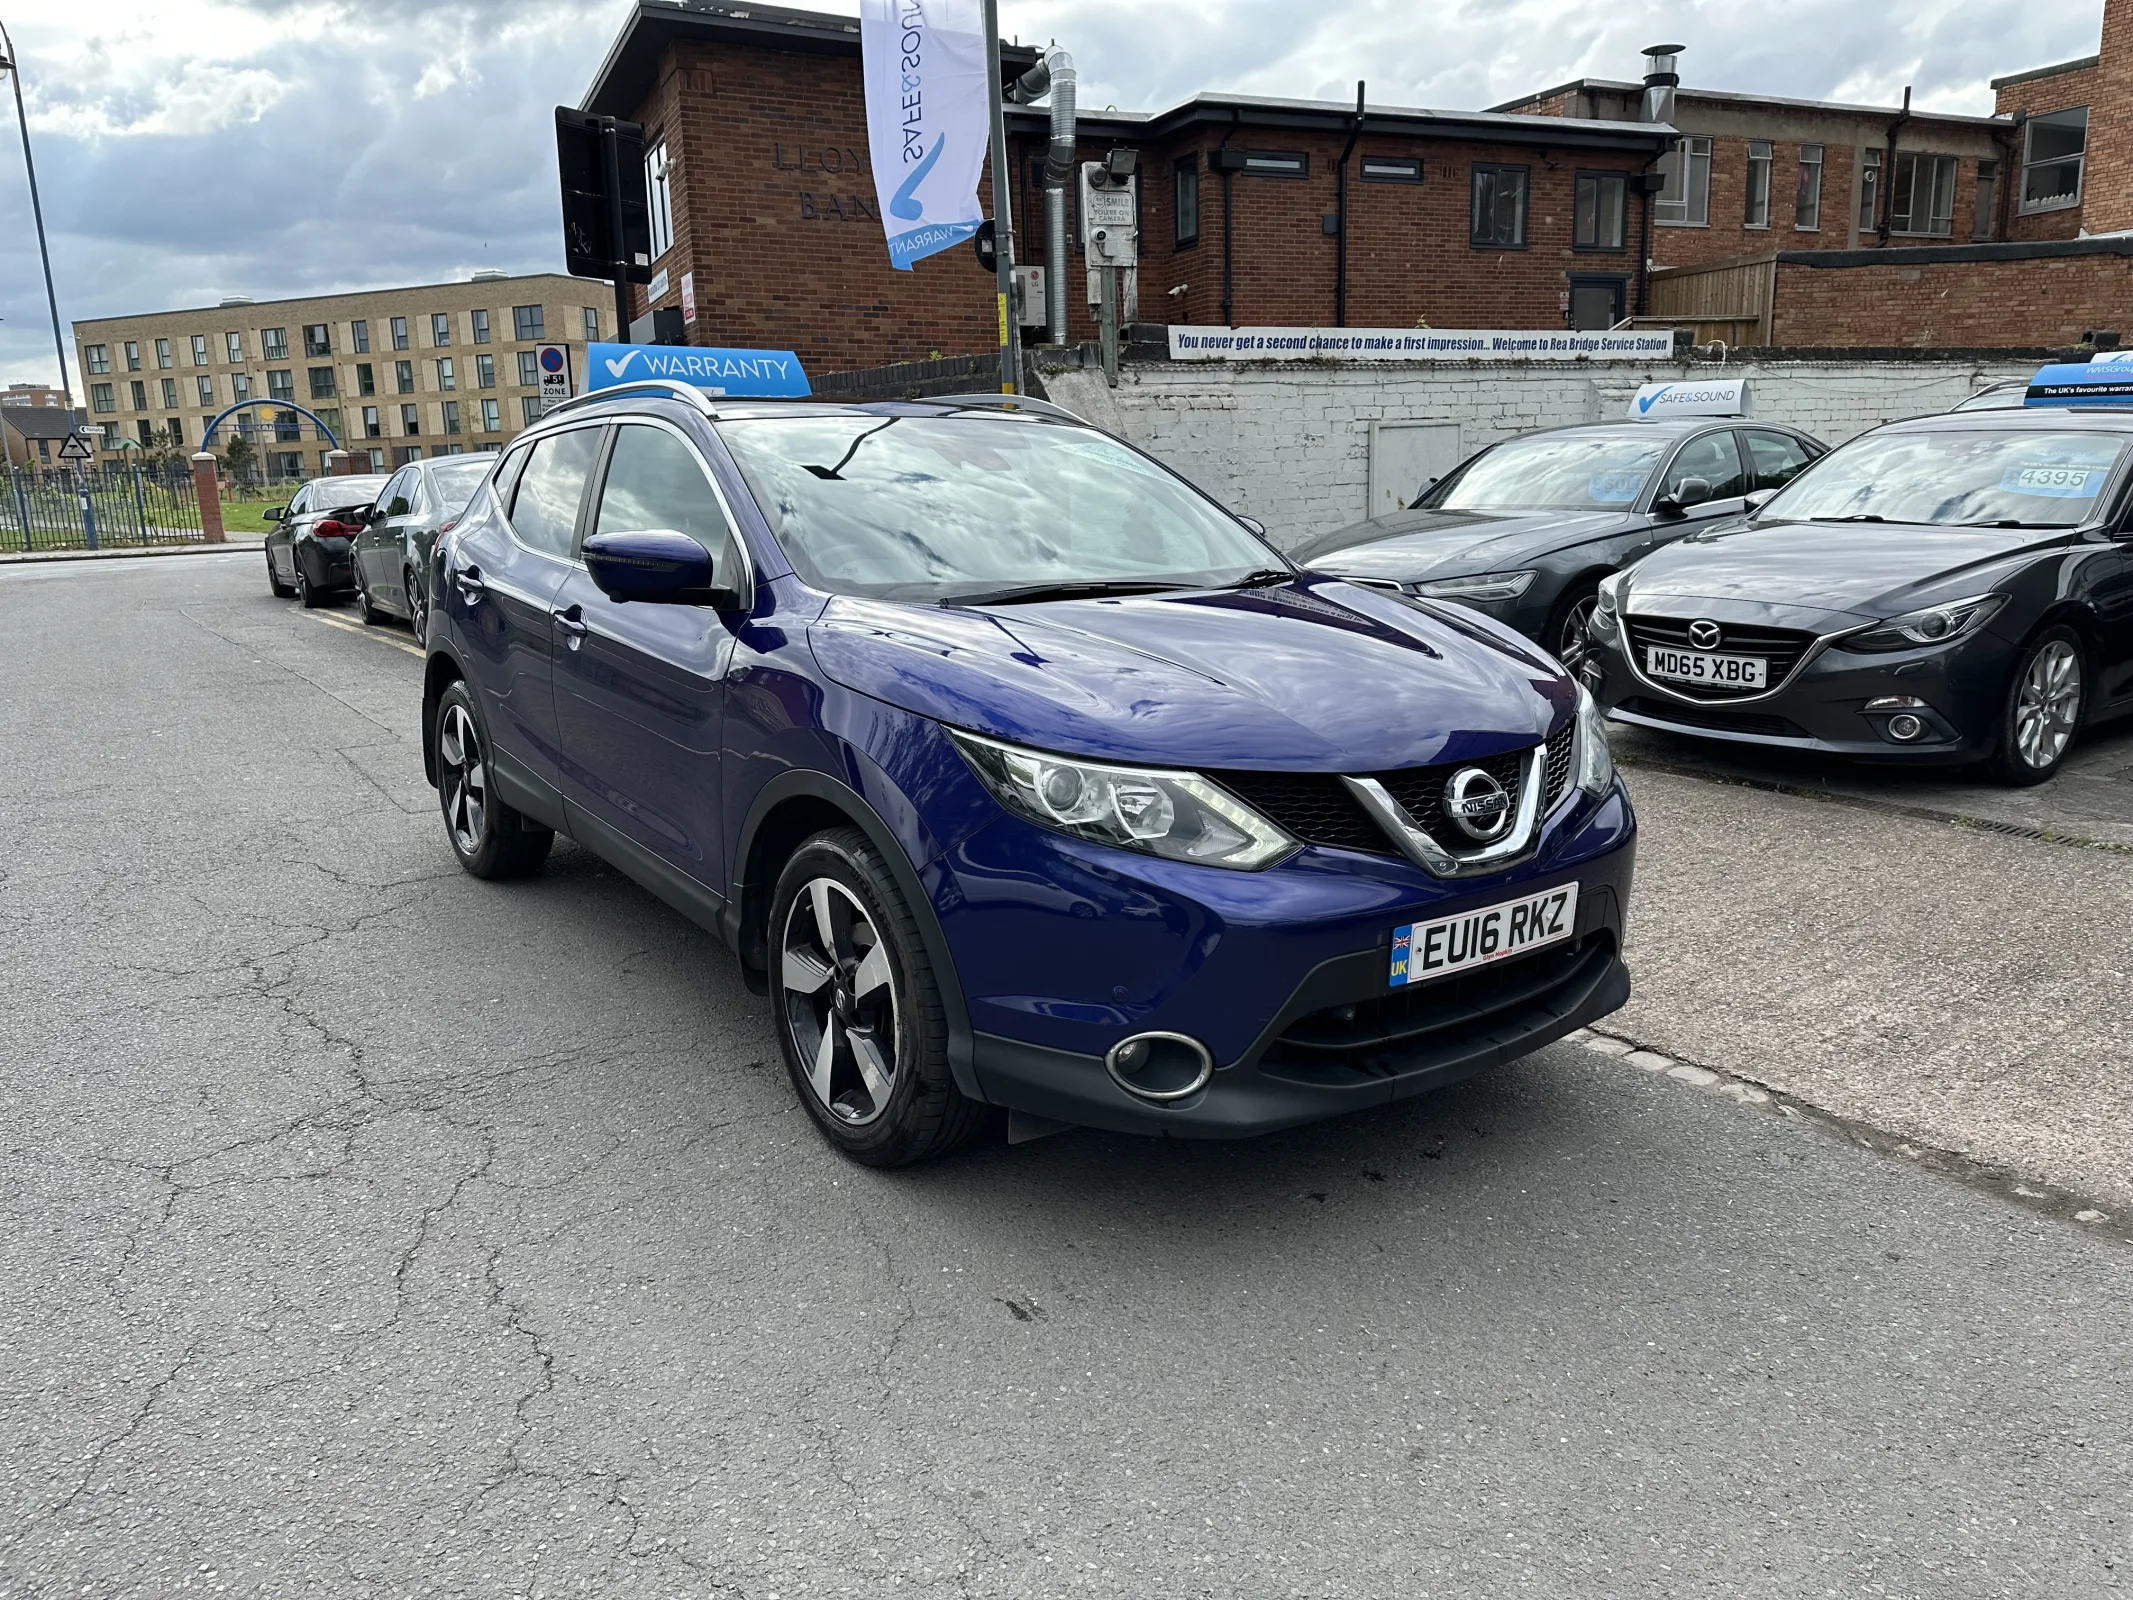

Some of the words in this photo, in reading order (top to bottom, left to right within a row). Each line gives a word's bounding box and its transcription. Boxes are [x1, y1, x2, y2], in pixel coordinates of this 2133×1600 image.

[1106, 197, 1129, 207] SMILE
[1178, 333, 1199, 349] You
[1201, 335, 1234, 349] never
[1236, 336, 1255, 351] get
[1256, 337, 1264, 349] a
[1266, 335, 1307, 350] second
[1309, 335, 1349, 350] chance
[1351, 336, 1363, 350] to
[1364, 336, 1393, 350] make
[1395, 338, 1402, 350] a
[1404, 336, 1426, 350] first
[1427, 337, 1491, 351] impression...
[1492, 337, 1537, 351] Welcome
[1539, 338, 1549, 351] to
[1550, 337, 1567, 351] Rea
[1569, 337, 1600, 352] Bridge
[1601, 337, 1635, 351] Service
[1637, 337, 1668, 351] Station
[642, 354, 788, 380] WARRANTY
[543, 387, 566, 395] ZONE
[1659, 390, 1735, 404] SAFE&SOUND
[2058, 386, 2075, 394] UK's
[2076, 385, 2108, 393] favourite
[1654, 651, 1705, 677] MD65
[1711, 659, 1756, 682] XBG
[1461, 797, 1506, 813] NISSAN
[1422, 911, 1501, 971] EU16
[1508, 891, 1568, 948] RKZ
[1482, 953, 1495, 961] Glyn
[1390, 959, 1407, 977] UK
